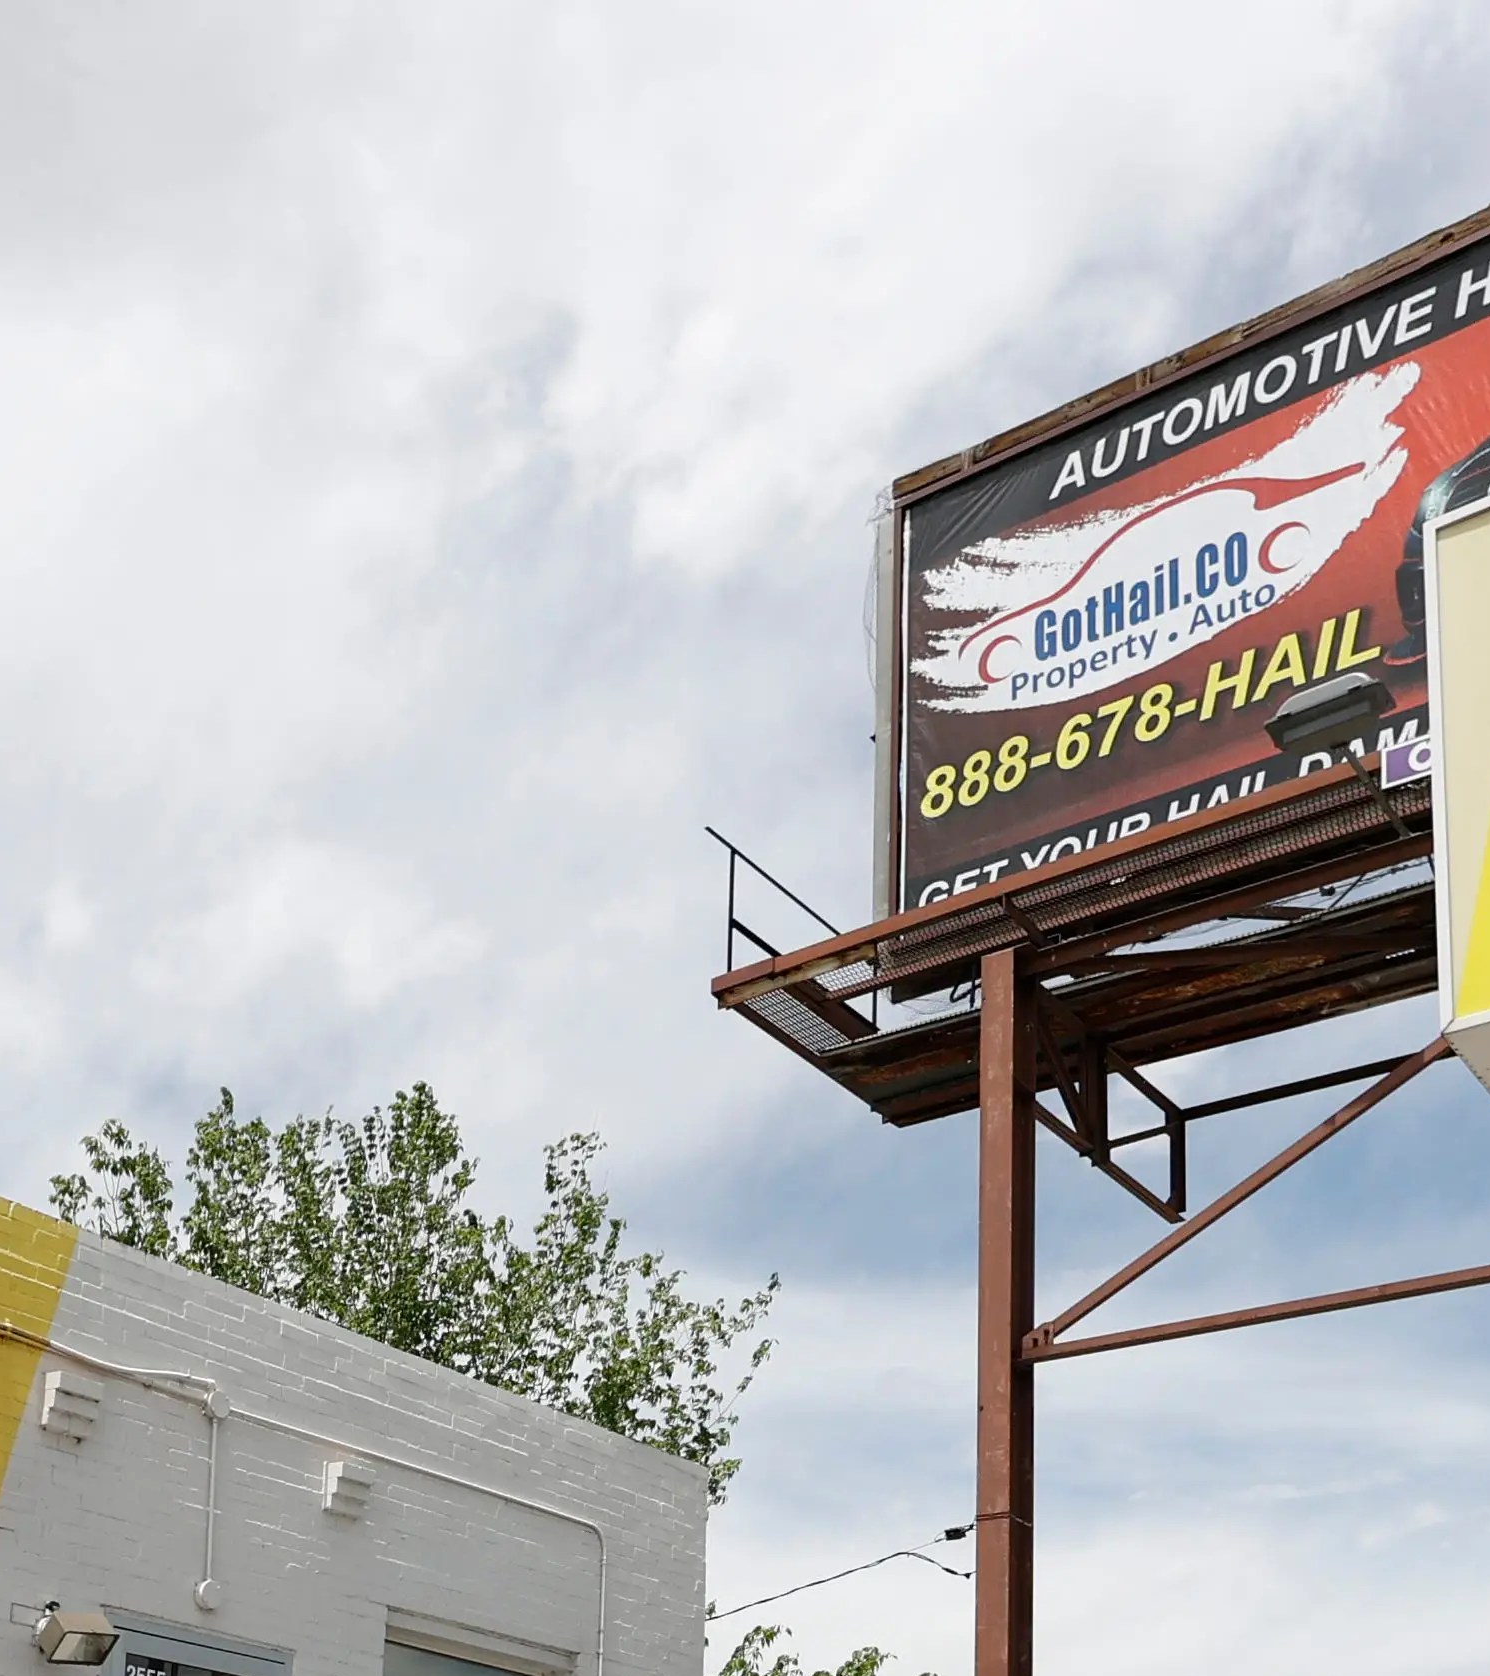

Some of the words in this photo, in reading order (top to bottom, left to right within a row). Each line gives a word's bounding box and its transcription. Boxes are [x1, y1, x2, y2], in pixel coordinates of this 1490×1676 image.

[1049, 286, 1437, 501] AUTOMOTIVE
[1010, 626, 1159, 700] Property
[1189, 583, 1276, 635] Auto
[1034, 531, 1248, 662] GotHail.CO
[919, 608, 1383, 819] 888-678-HAIL
